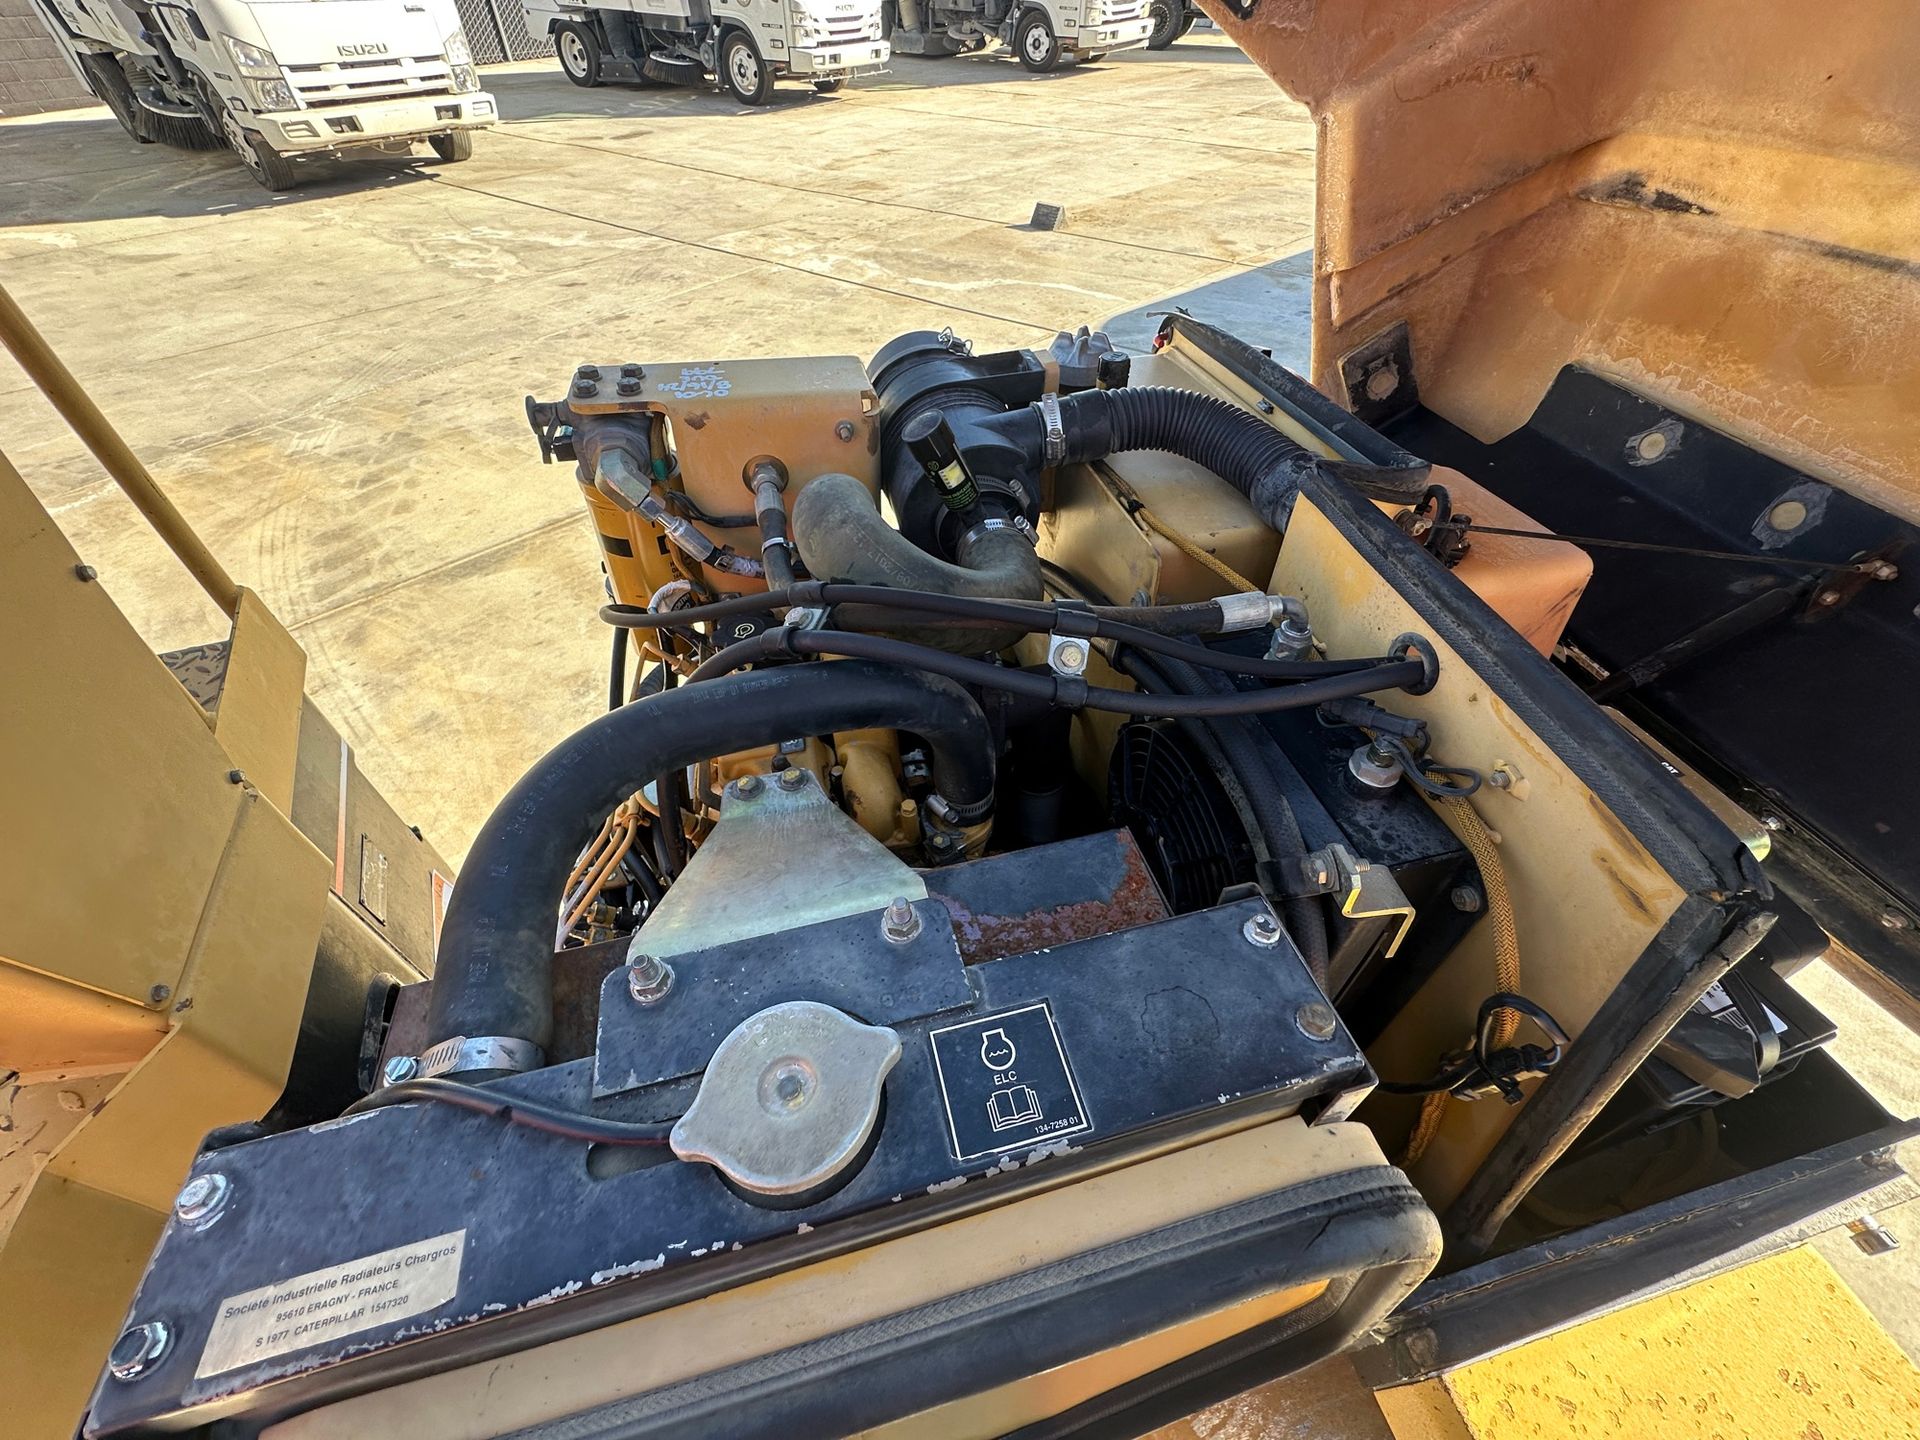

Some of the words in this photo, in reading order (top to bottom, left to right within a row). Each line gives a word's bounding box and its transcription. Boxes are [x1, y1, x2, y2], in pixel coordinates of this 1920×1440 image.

[337, 42, 388, 57] ISUZU
[993, 1071, 1018, 1085] ELC
[1035, 1118, 1068, 1134] 134-7258
[1069, 1116, 1079, 1126] 01
[272, 1279, 337, 1306] Industrielle
[340, 1261, 401, 1286] Radiateurs
[405, 1245, 457, 1267] Chargros
[275, 1307, 304, 1323] 95610
[307, 1295, 351, 1314] ERAGNY
[358, 1280, 399, 1299] FRANCE
[256, 1337, 264, 1348] S
[266, 1329, 290, 1344] 1977
[294, 1308, 365, 1337] CATERPILLAR
[370, 1295, 409, 1314] 1547320
